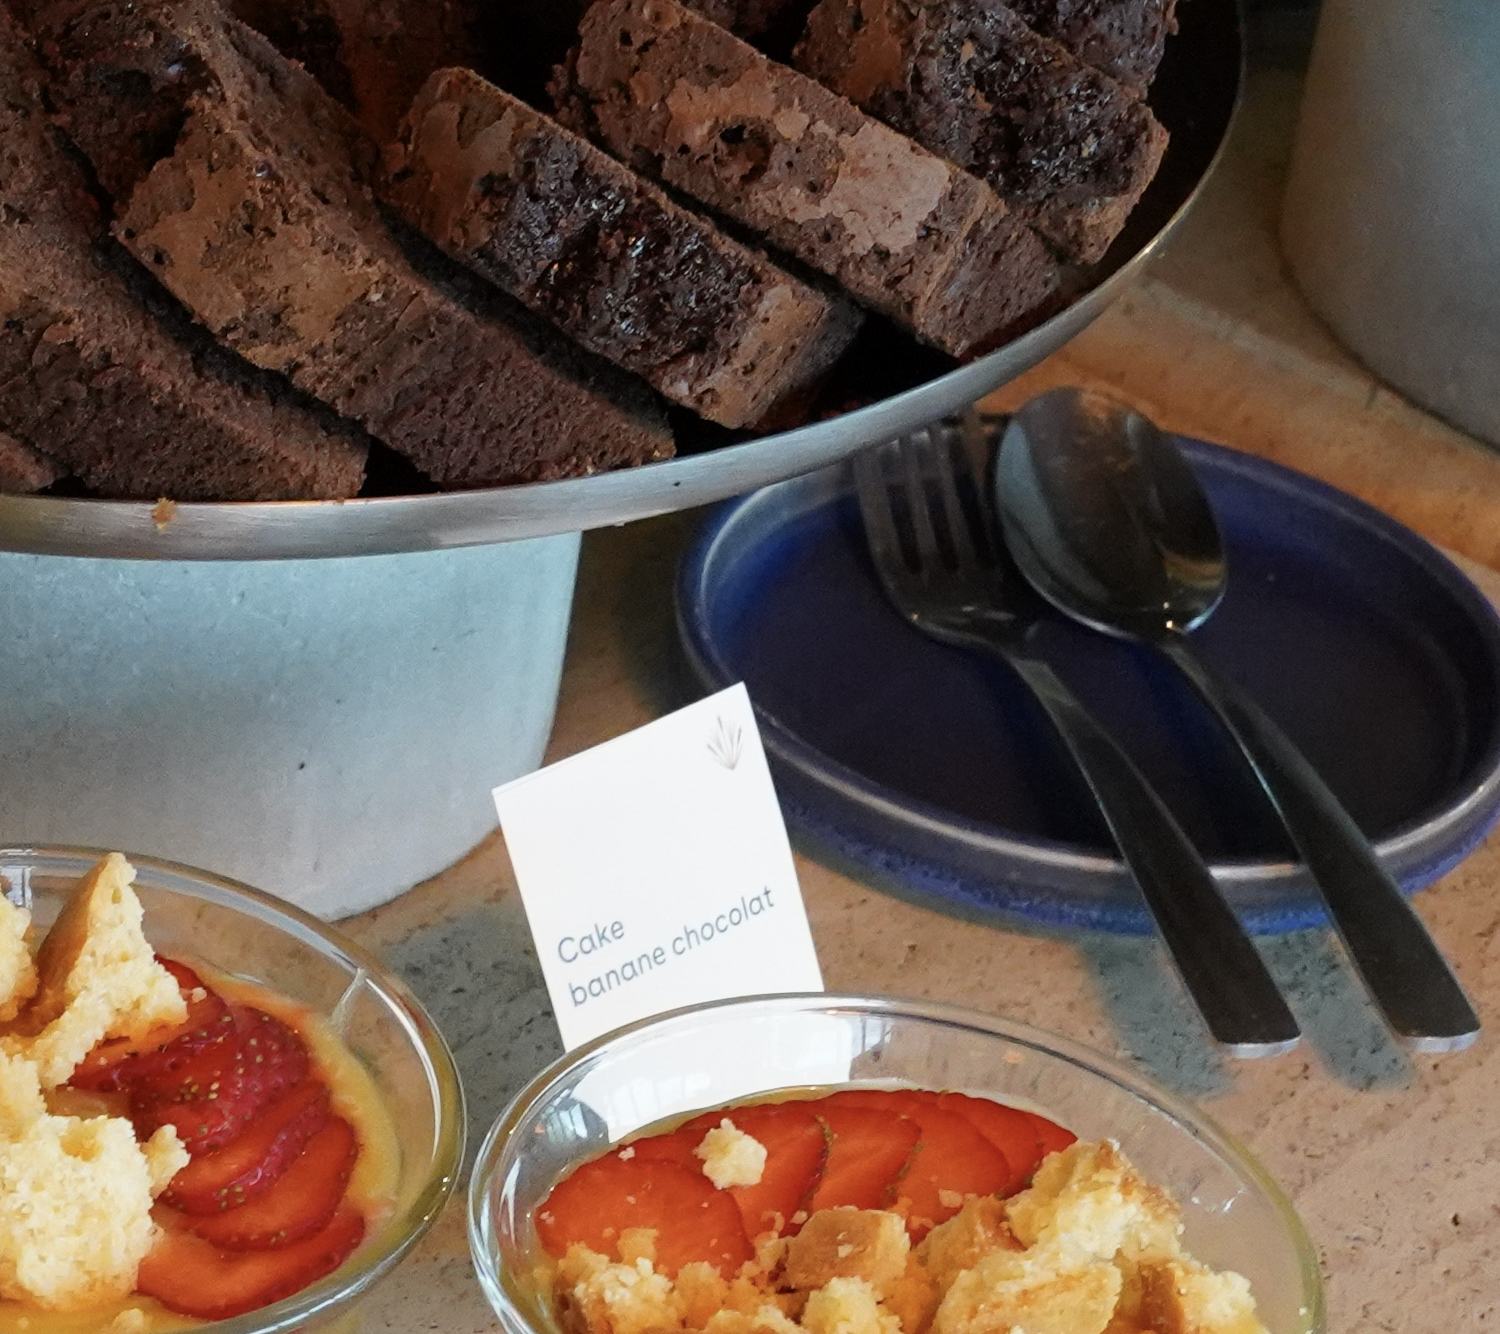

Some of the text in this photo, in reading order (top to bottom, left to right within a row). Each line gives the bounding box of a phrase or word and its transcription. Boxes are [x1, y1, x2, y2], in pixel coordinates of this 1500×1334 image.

[557, 920, 625, 963] Cake
[568, 886, 775, 1007] banane chocolat
